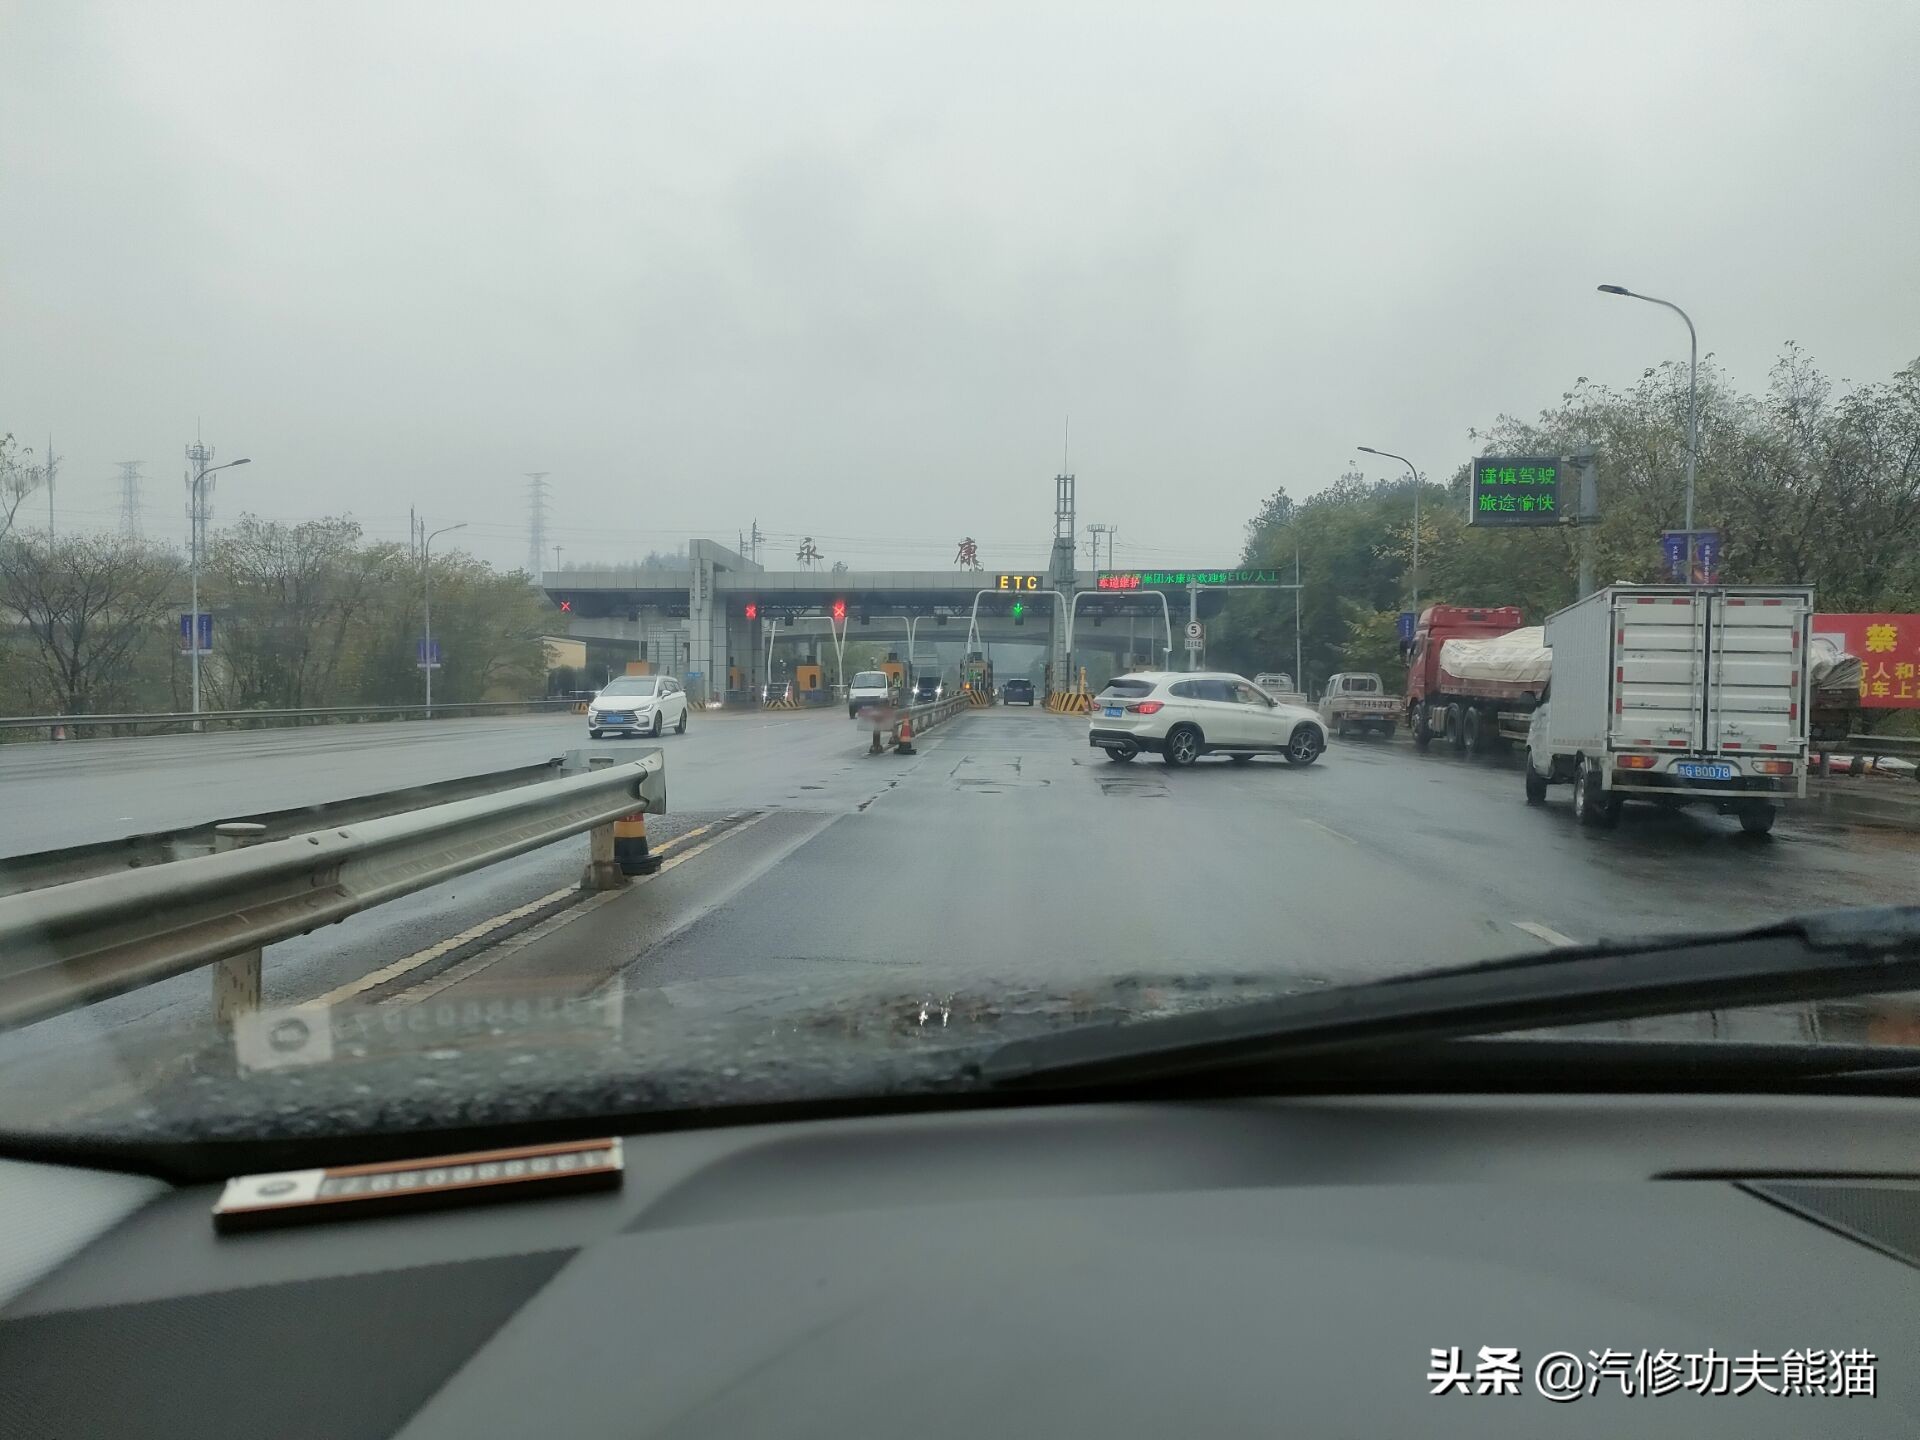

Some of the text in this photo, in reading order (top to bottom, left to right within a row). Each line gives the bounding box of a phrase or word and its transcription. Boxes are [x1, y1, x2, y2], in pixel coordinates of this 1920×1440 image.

[1479, 467, 1556, 485] 谨慎驾驶
[1479, 494, 1555, 512] 旅途愉快
[796, 536, 984, 572] 永 康
[999, 575, 1037, 589] ETC
[1190, 625, 1197, 635] 5
[1865, 623, 1898, 653] 禁
